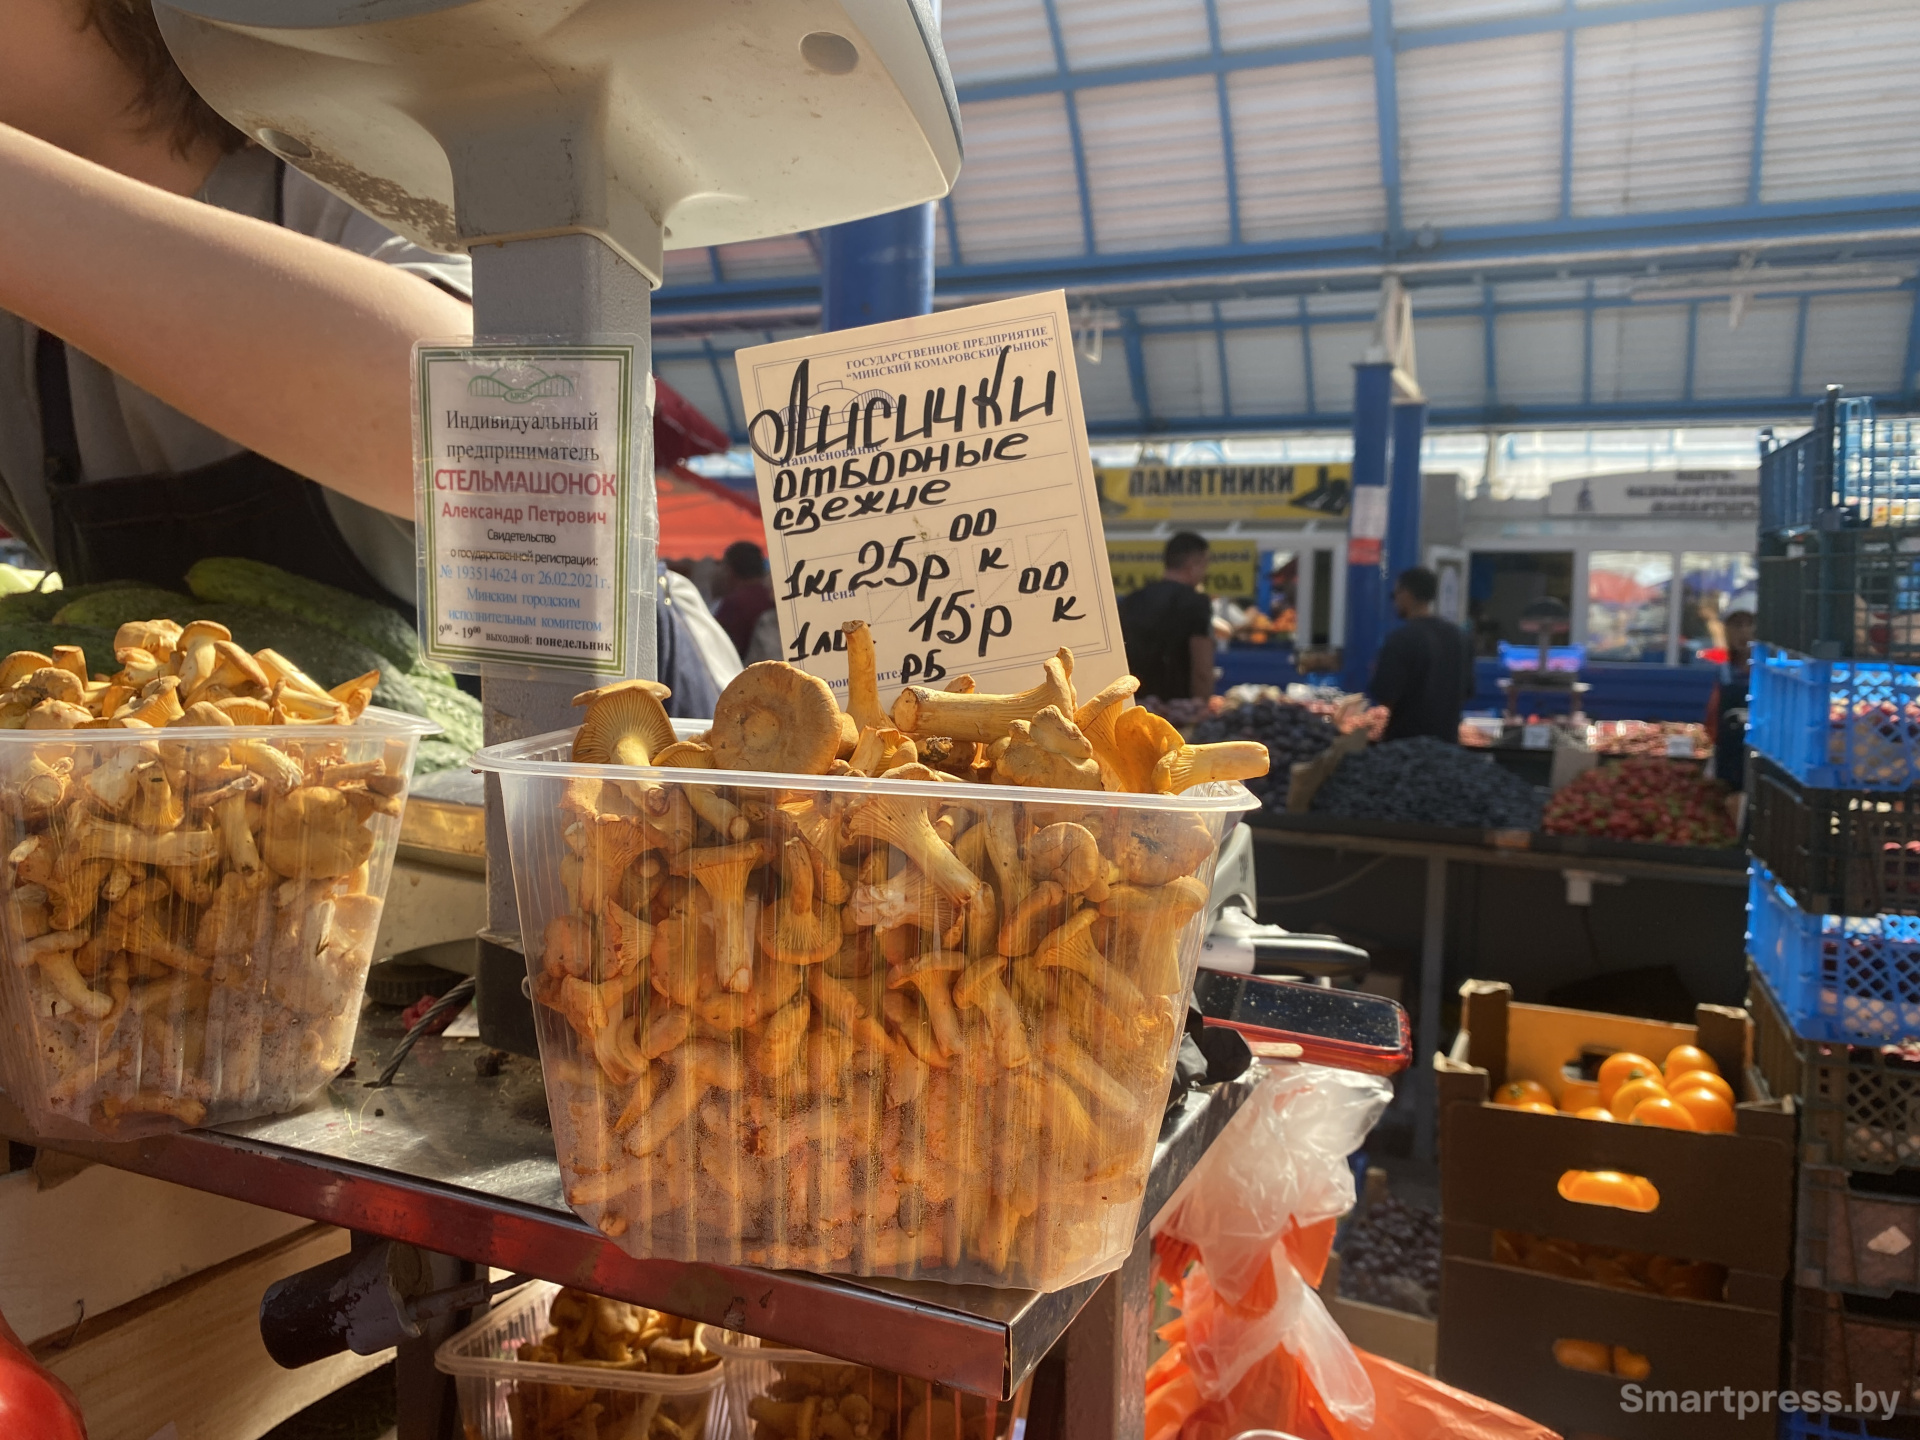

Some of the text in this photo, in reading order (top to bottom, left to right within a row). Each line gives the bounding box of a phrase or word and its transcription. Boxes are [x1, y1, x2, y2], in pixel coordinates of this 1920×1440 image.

[846, 326, 1048, 370] ГОСУДАРСТВЕННОЕ ПРЕДПРИЯТИЕ
[748, 345, 1057, 466] Лисички
[446, 410, 599, 434] Индивидуальный
[446, 444, 600, 463] предприниматель
[434, 468, 617, 496] СТЕЛЬМАШОНОК
[1129, 466, 1295, 496] ПАМЯТНИКИ
[441, 502, 607, 525] Александр Петрович
[487, 528, 556, 543] Свидетельство
[450, 549, 599, 567] о государственной регистрации:
[440, 564, 453, 578] №
[457, 566, 518, 583] 193514624
[521, 572, 535, 584] от
[466, 587, 581, 609] Минским городским
[820, 589, 856, 602] Цена
[448, 609, 602, 632] исполнительным комитетом
[485, 630, 533, 645] выходной:
[535, 635, 612, 652] понедельник
